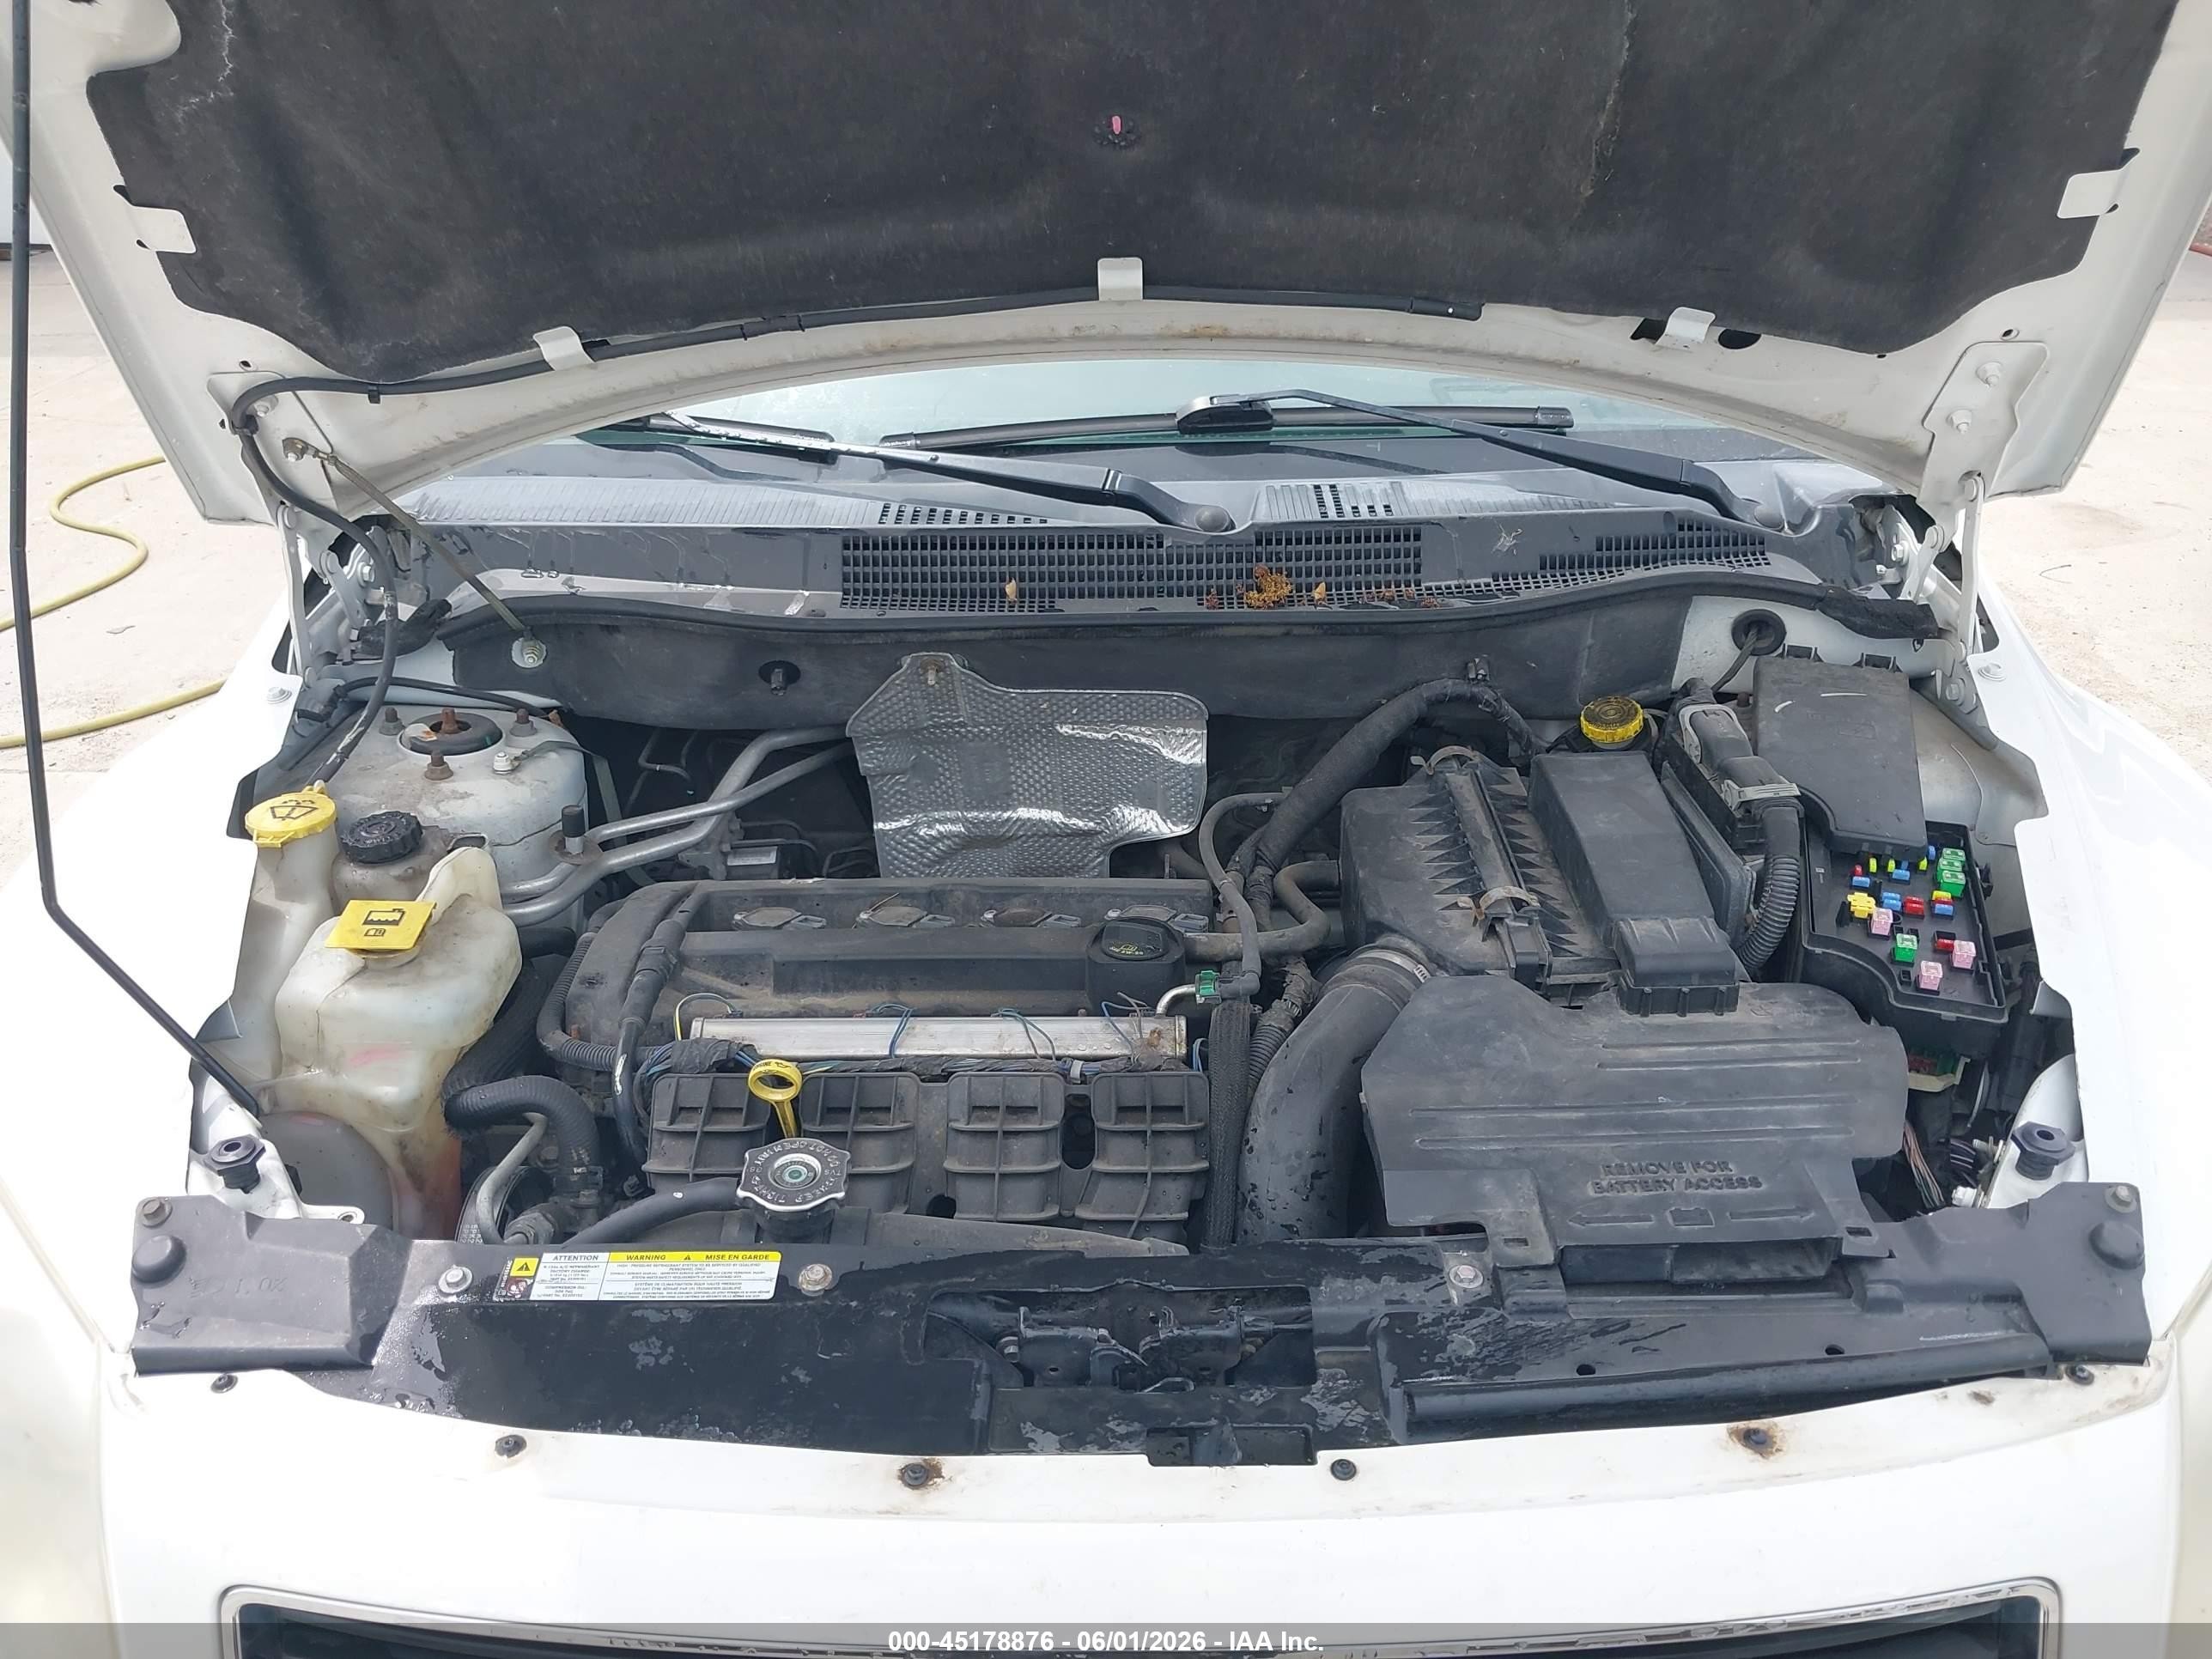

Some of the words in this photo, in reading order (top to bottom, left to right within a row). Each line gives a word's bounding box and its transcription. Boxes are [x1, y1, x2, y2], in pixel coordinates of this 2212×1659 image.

[1601, 1161, 1686, 1176] REMOVE
[1690, 1160, 1734, 1174] FOR
[1589, 1178, 1675, 1194] BATTERY
[1683, 1176, 1763, 1191] ACCESS
